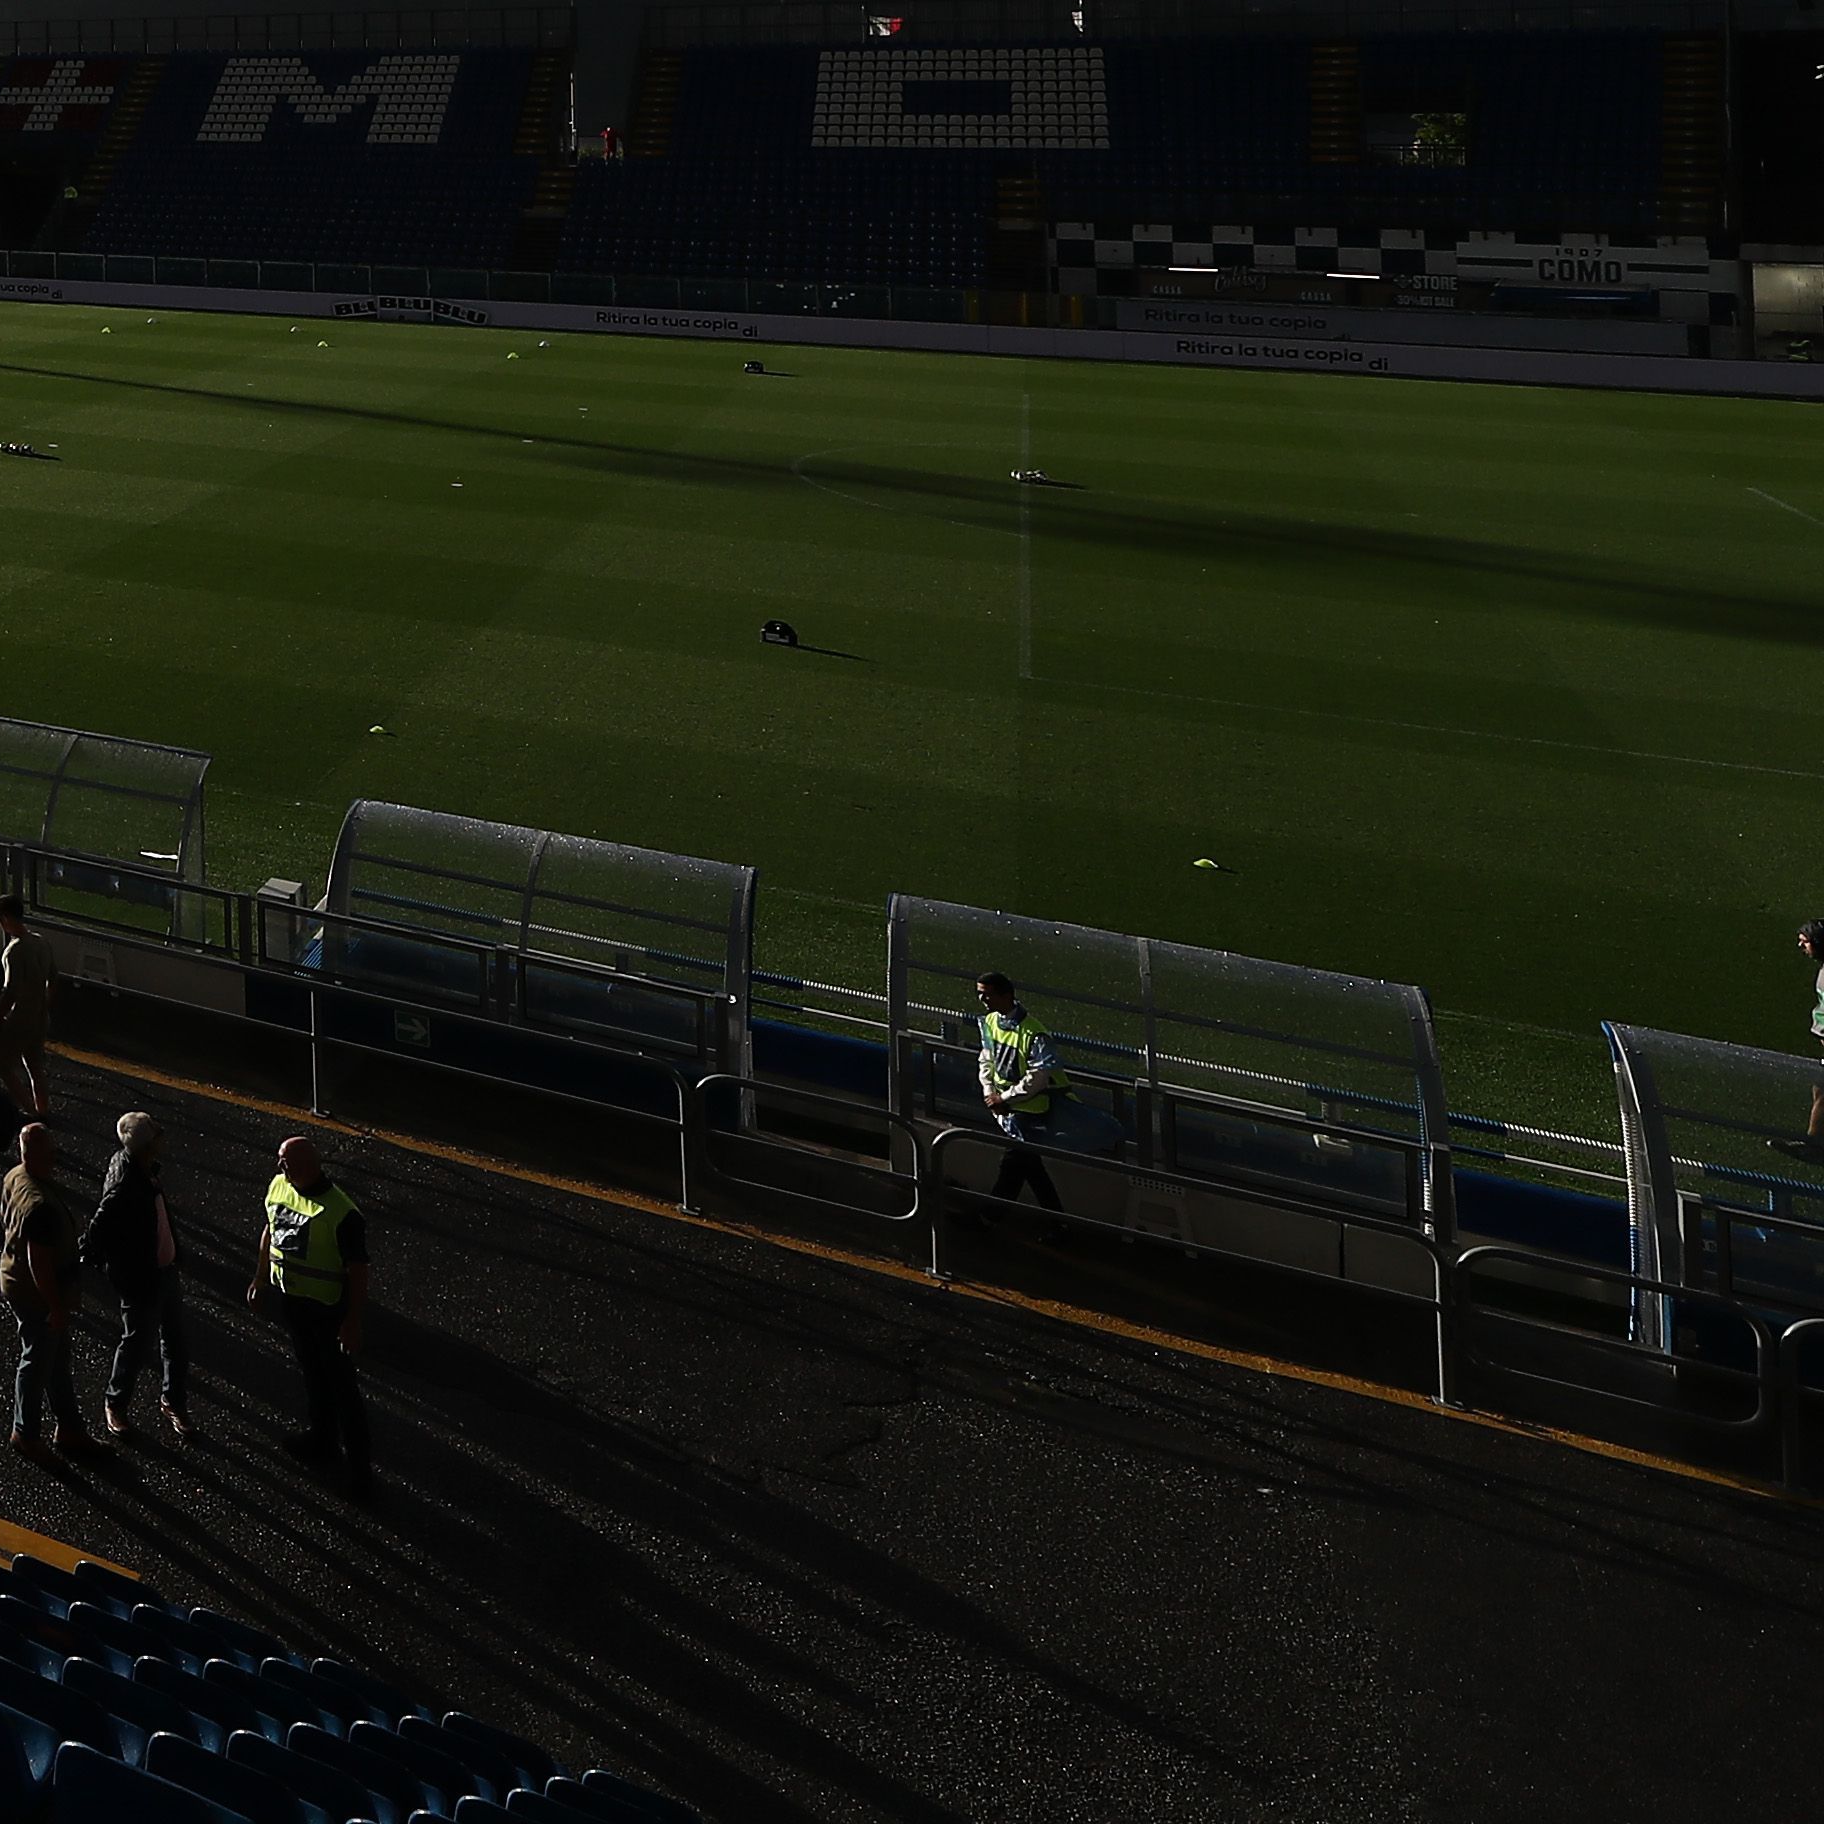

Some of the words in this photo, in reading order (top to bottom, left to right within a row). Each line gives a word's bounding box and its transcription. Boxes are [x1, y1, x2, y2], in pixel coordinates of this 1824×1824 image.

[1554, 248, 1603, 258] 1907
[1538, 258, 1623, 284] COMO
[17, 283, 49, 295] copia
[51, 289, 63, 300] di
[1412, 274, 1459, 291] STORE
[379, 297, 431, 310] BLU
[596, 311, 640, 325] Ritira
[643, 314, 658, 326] la
[662, 316, 690, 327] tua
[693, 318, 738, 332] copia
[742, 326, 758, 338] di
[1145, 309, 1201, 323] Ritira
[1205, 311, 1223, 324] la
[1229, 313, 1264, 326] tua
[1269, 315, 1327, 331] copia
[1176, 340, 1233, 356] Ritira
[1239, 343, 1257, 357] la
[1263, 345, 1299, 359] tua
[1304, 348, 1363, 364] copia
[1369, 358, 1389, 371] di
